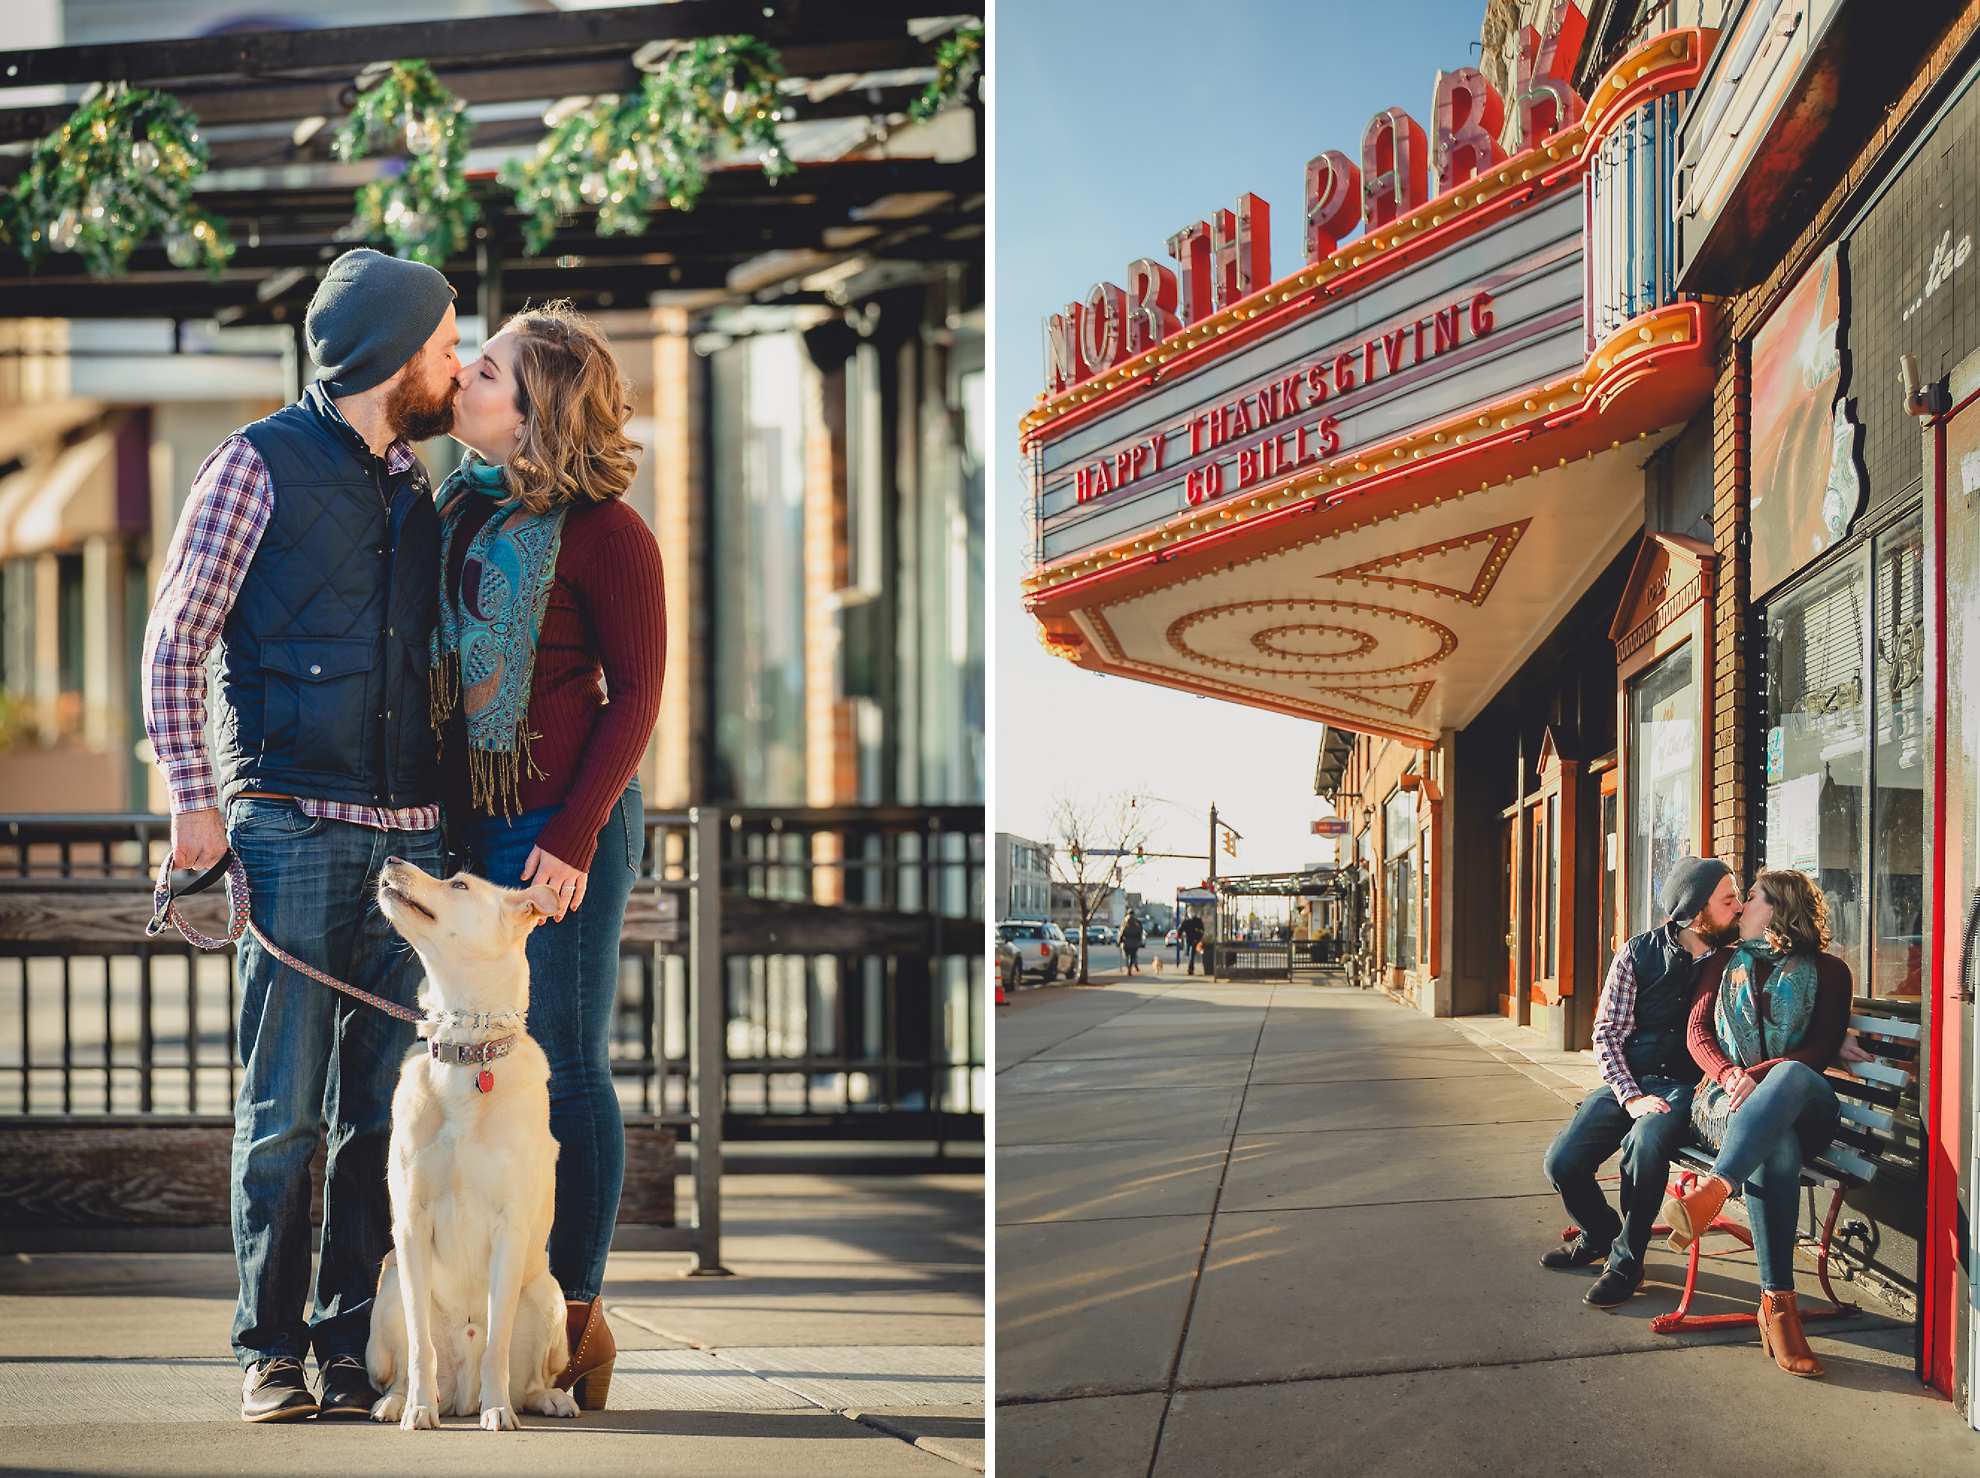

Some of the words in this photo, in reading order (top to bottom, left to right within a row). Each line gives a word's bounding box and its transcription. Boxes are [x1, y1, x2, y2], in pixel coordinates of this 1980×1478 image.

[1042, 191, 1272, 396] NORTH
[1302, 0, 1588, 267] PARK
[1074, 433, 1166, 504] HAPPY
[1185, 292, 1495, 457] THANKSGIVING
[1184, 462, 1223, 507] GO
[1236, 415, 1341, 488] BILLS
